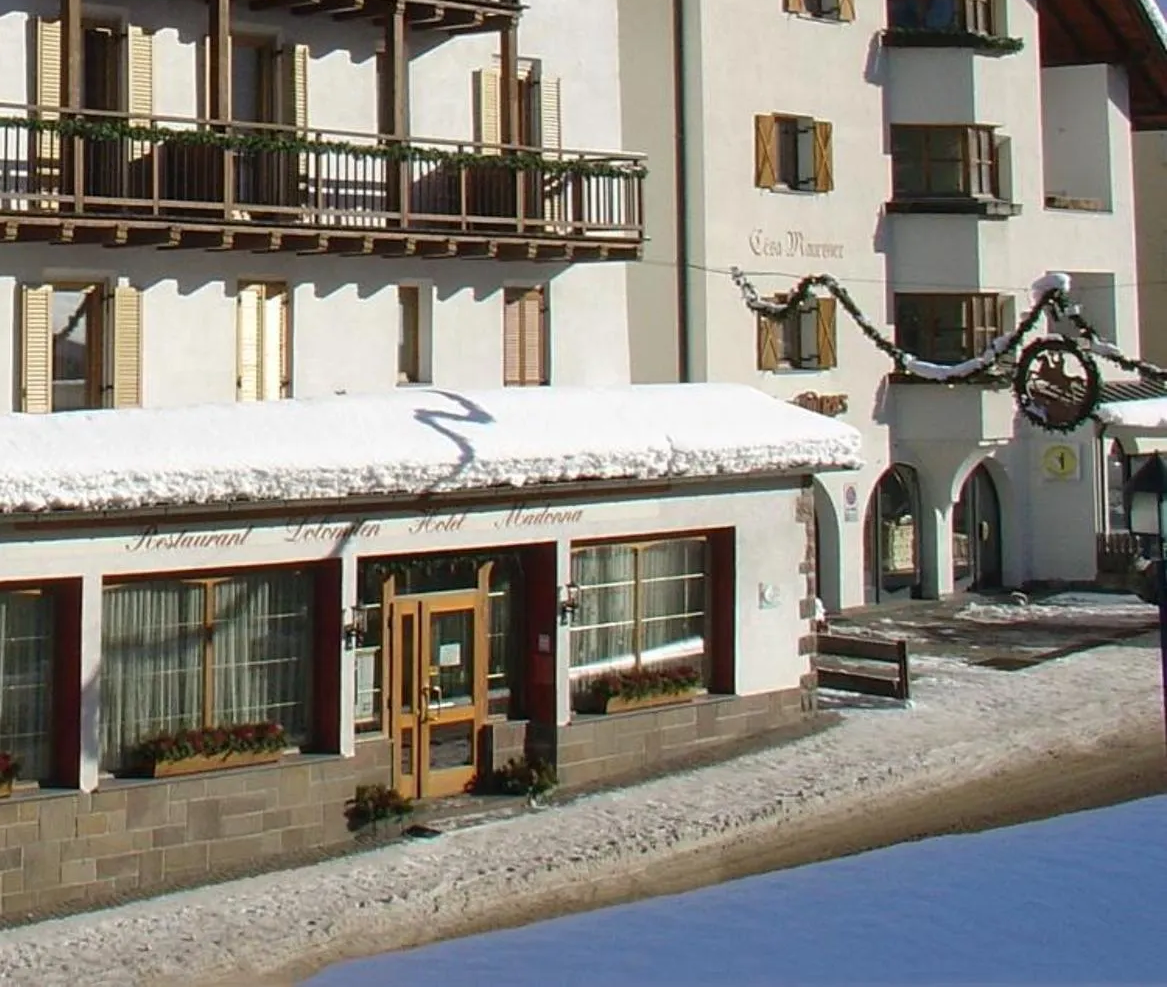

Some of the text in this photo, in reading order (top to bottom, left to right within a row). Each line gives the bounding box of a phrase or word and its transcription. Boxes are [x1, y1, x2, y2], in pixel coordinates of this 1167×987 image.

[125, 524, 253, 550] Restaurant
[408, 508, 472, 534] Hotel
[493, 502, 583, 529] Madonna
